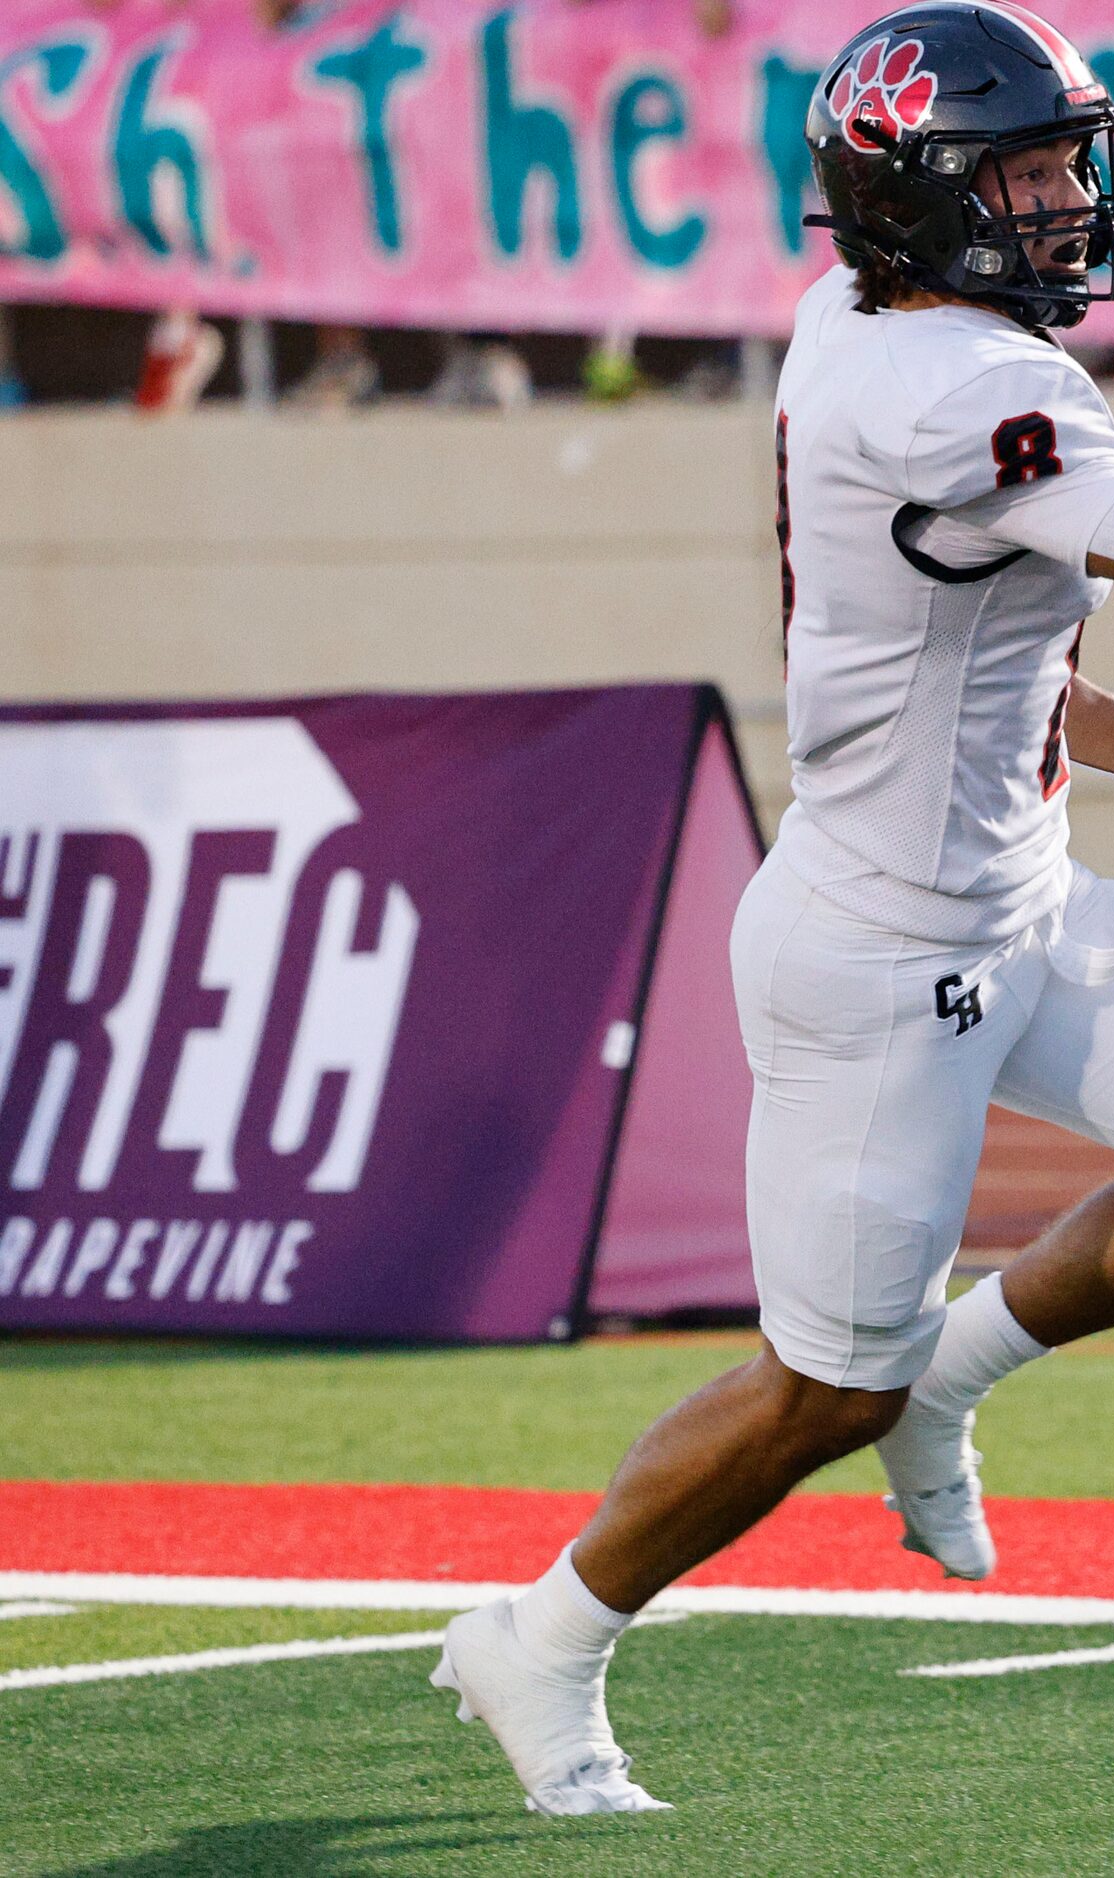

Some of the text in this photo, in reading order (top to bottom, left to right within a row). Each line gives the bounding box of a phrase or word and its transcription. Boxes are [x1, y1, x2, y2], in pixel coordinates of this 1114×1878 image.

[314, 12, 706, 268] the
[992, 411, 1063, 489] 8
[935, 972, 984, 1038] CH
